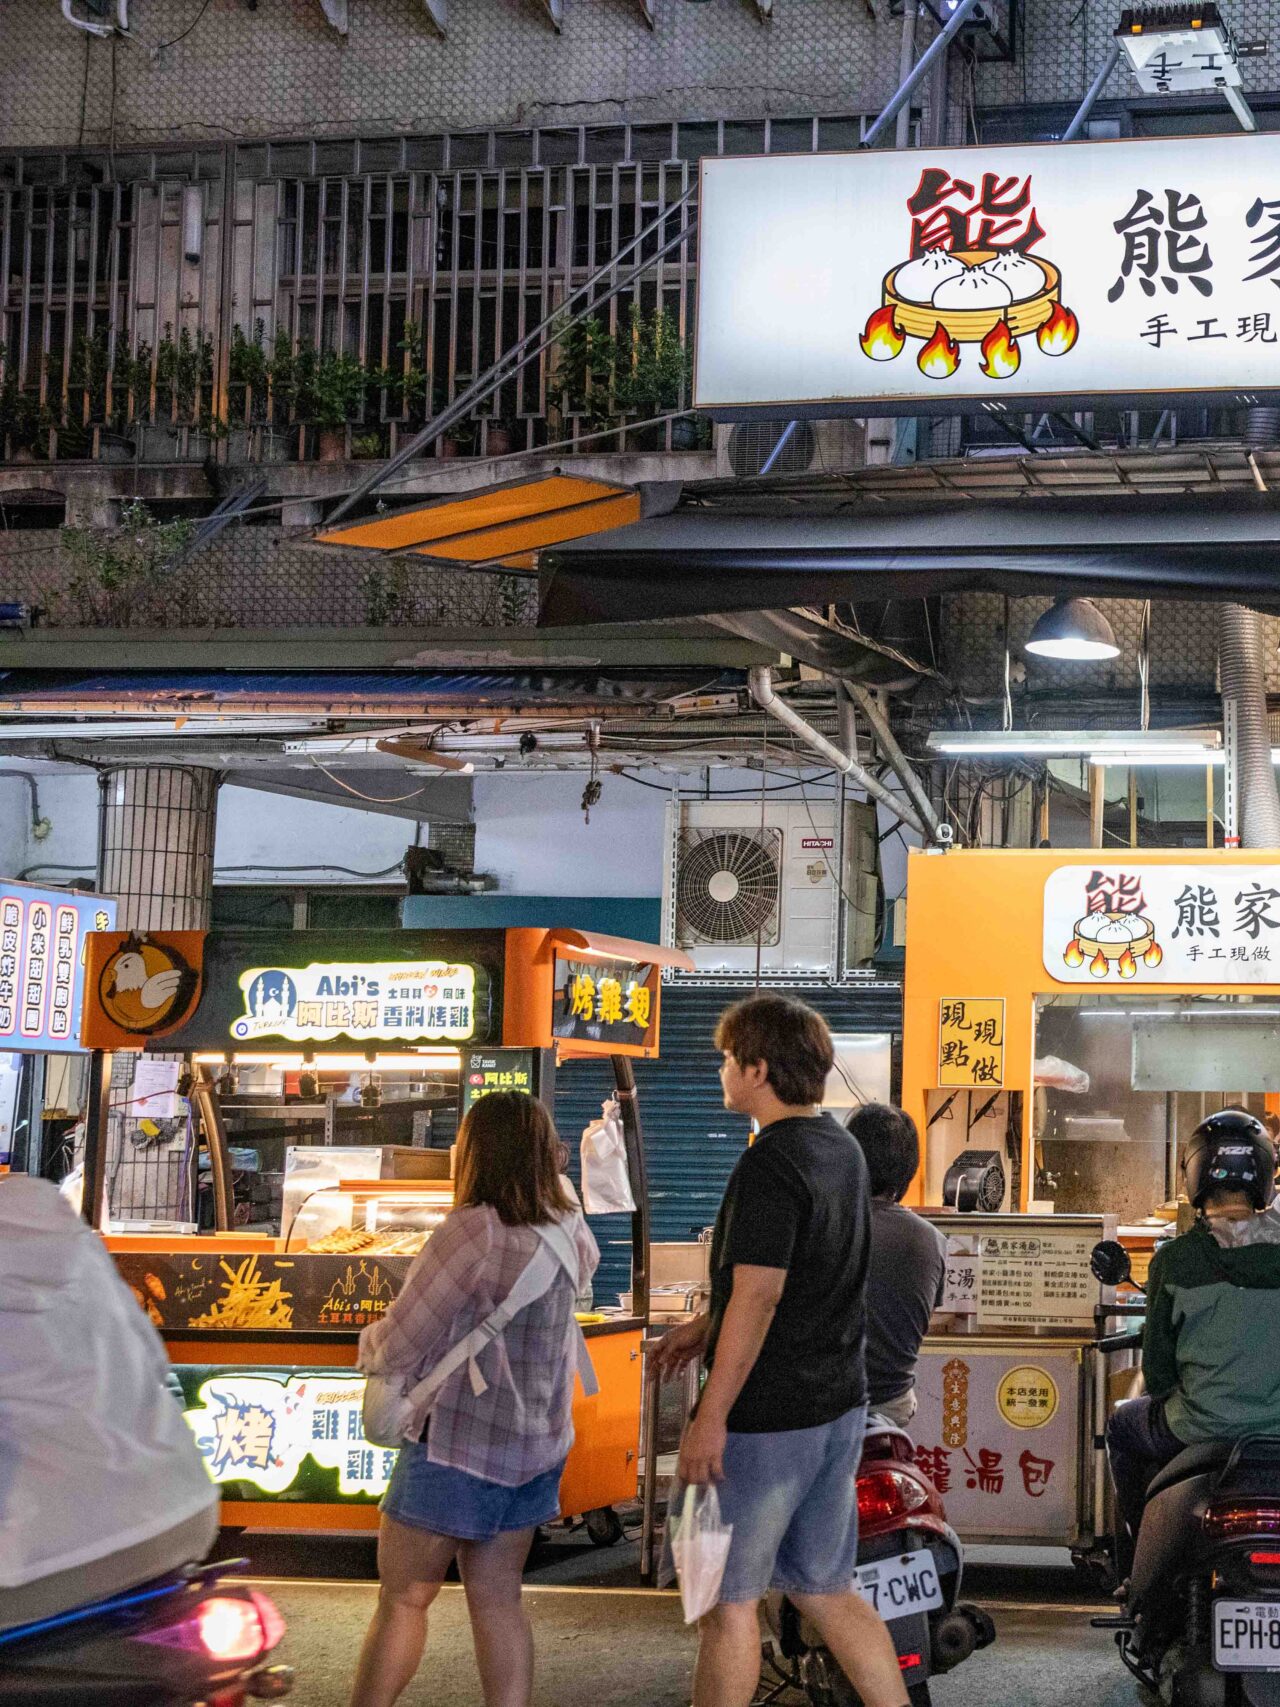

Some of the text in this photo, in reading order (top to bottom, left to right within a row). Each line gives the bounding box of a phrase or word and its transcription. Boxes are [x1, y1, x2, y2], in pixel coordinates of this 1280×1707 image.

[25, 908, 47, 1031] 小米甜甜圈
[52, 912, 74, 1033] 鮮乳雙胞胎
[316, 975, 380, 996] Abi's
[571, 974, 650, 1029] 烤雞翅
[296, 1001, 469, 1028] 阿比斯 香料烤雞
[484, 1072, 528, 1085] 阿比斯
[1218, 1146, 1253, 1155] MZR
[320, 1297, 351, 1313] Abi's
[318, 1312, 384, 1324] 土耳其香料
[1006, 1387, 1049, 1397] 本店免用
[1006, 1399, 1049, 1408] 統一發票
[213, 1407, 275, 1470] 烤
